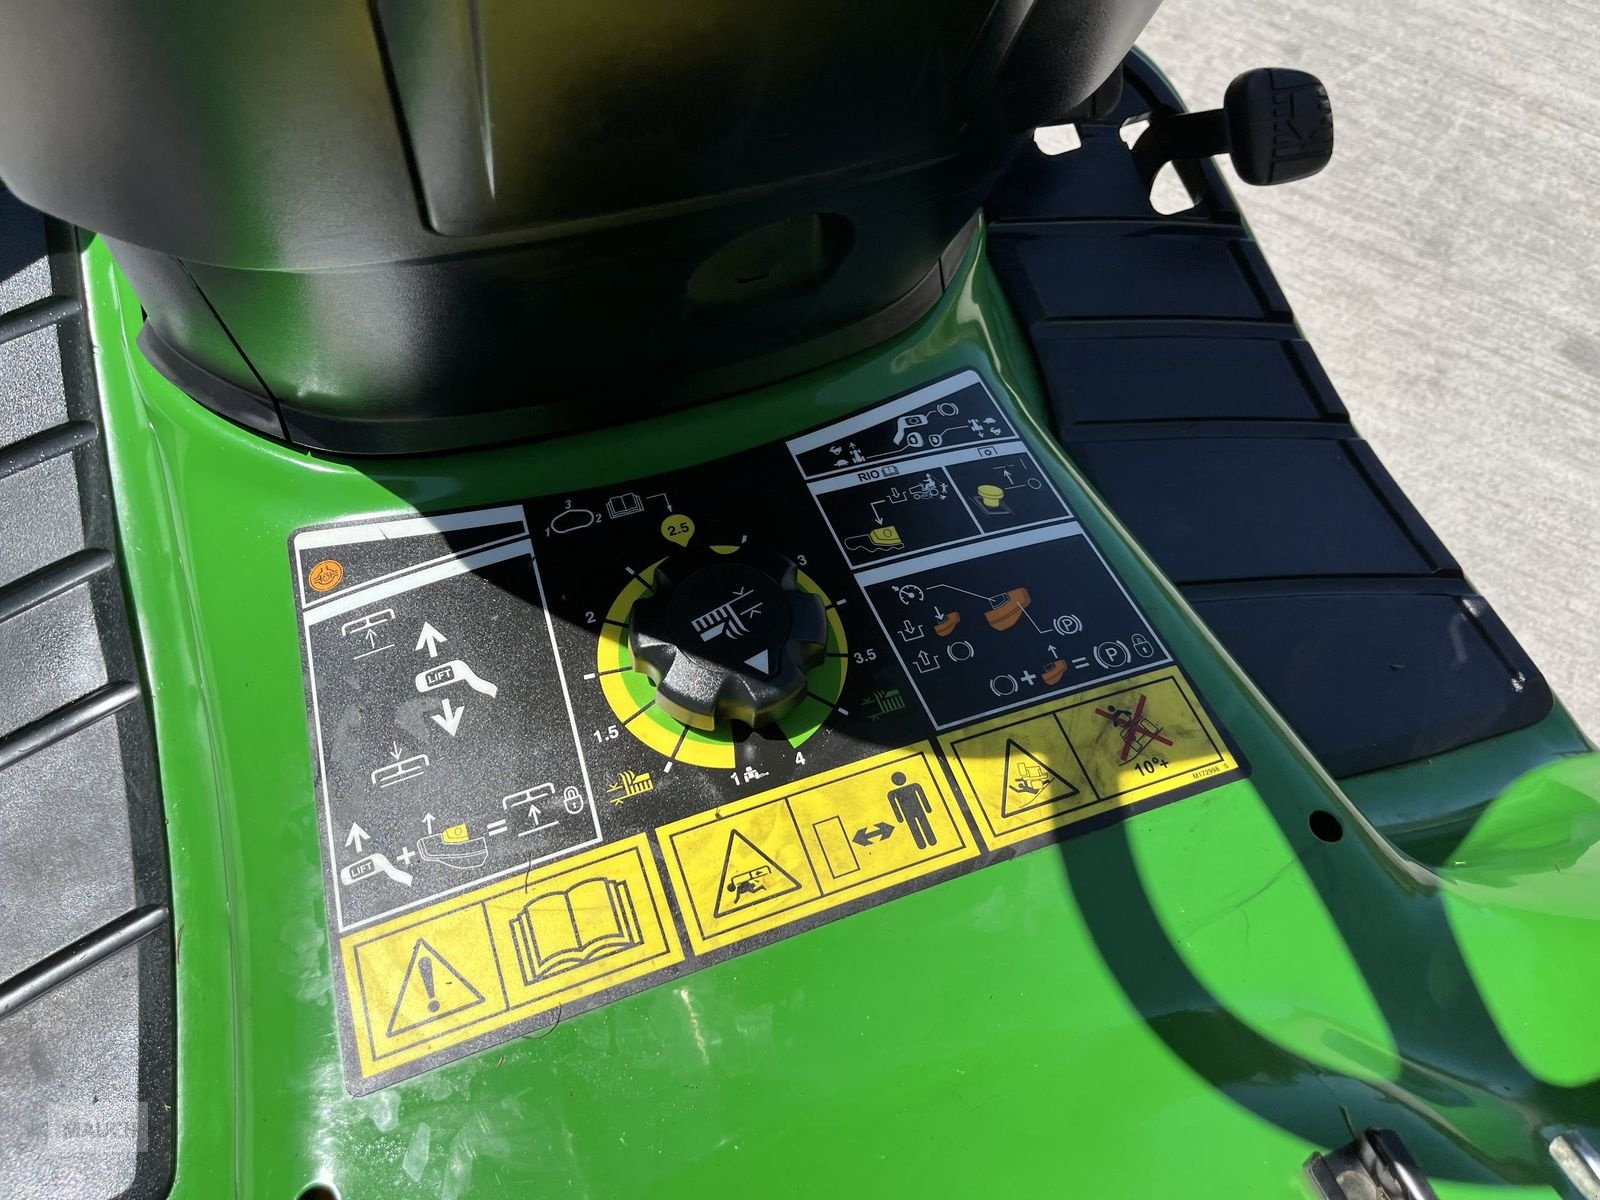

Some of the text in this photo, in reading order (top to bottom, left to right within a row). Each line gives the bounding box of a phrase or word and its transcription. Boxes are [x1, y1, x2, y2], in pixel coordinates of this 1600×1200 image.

[857, 469, 881, 483] RIO
[564, 499, 572, 510] 3
[595, 513, 602, 524] 2
[544, 526, 551, 537] 1
[667, 522, 690, 537] 2.5
[796, 554, 808, 566] 3
[585, 611, 597, 624] 2
[853, 648, 878, 664] 3.5
[427, 668, 452, 684] LIFT
[593, 725, 620, 743] 1.5
[794, 751, 806, 766] 4
[730, 771, 741, 786] 1
[350, 861, 373, 878] LIFT
